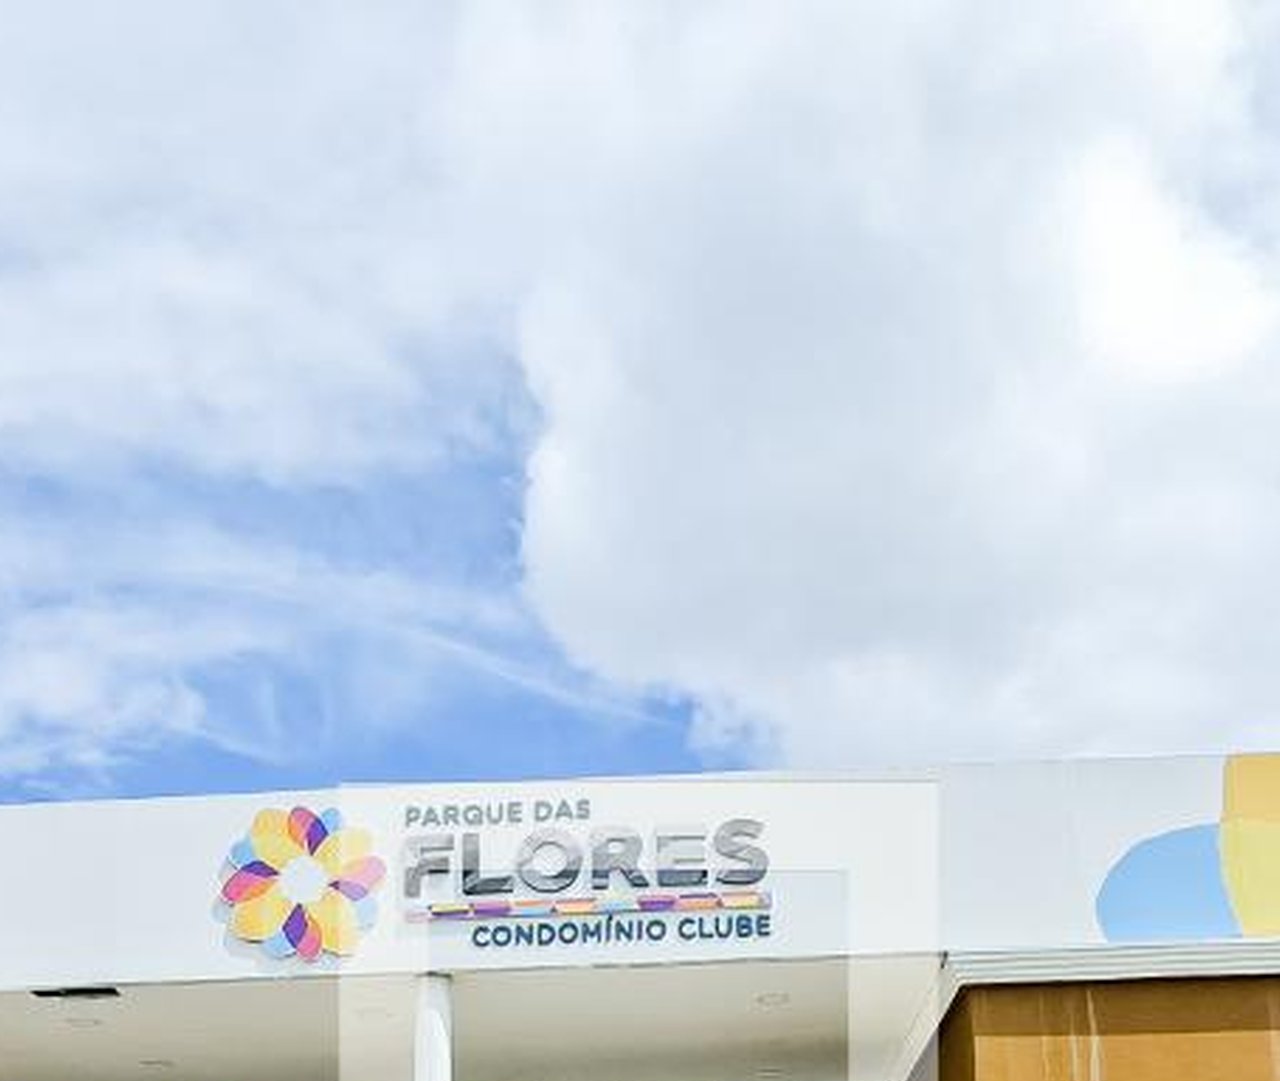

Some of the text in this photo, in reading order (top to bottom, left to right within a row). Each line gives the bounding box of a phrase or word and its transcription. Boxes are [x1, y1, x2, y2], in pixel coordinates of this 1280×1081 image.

[405, 800, 591, 827] PARQUE DAS
[404, 818, 770, 898] FLORES
[471, 913, 771, 947] CONDOMÍNIO CLUBE
